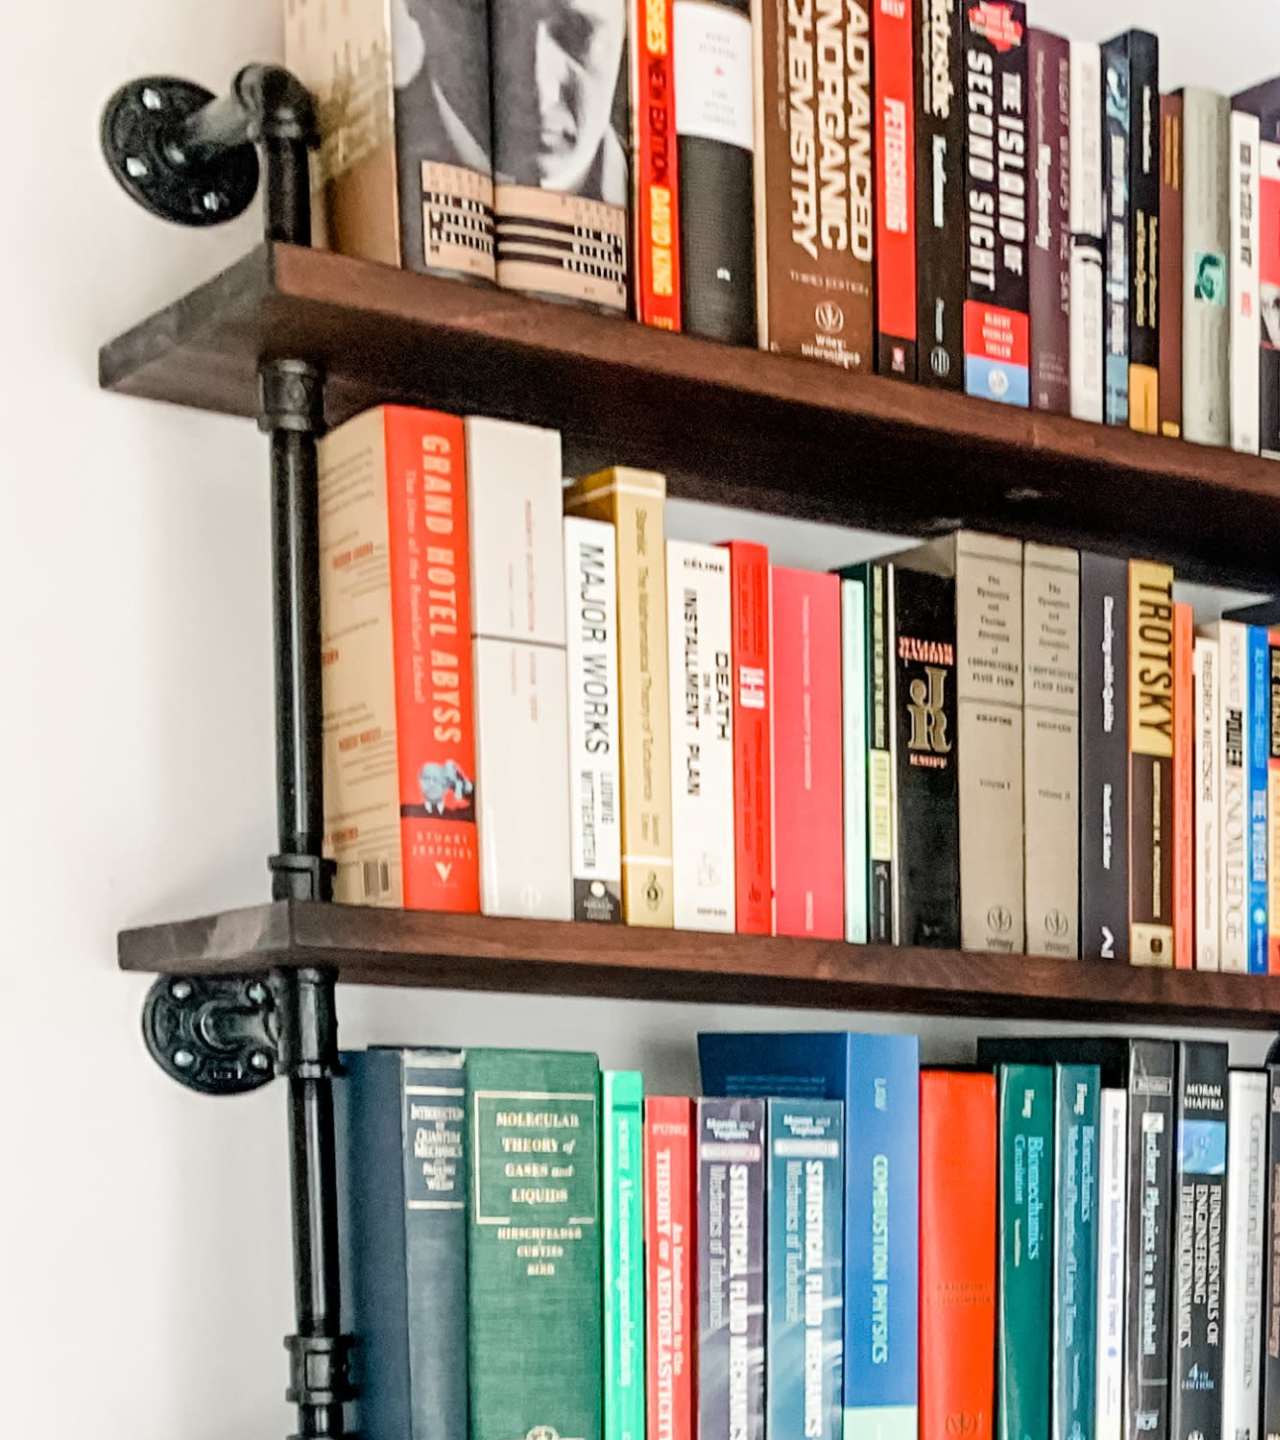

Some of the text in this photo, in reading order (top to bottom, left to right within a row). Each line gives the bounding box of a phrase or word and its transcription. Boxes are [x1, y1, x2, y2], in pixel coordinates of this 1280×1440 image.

[846, 2, 873, 262] ADVANCED
[967, 50, 996, 292] SECOND SIGHT
[421, 434, 463, 745] GRAND HOTEL ABYSS
[578, 542, 610, 756] MAJOR WORKS
[683, 588, 700, 796] INSTALLMENT PLAN
[714, 651, 731, 742] DEATH
[1136, 580, 1174, 742] TROTSKY
[496, 1110, 581, 1129] MOLECULAR
[501, 1137, 577, 1155] THEORY of
[1183, 1095, 1225, 1111] SHAPIRO
[1185, 1084, 1222, 1099] MORAN
[504, 1161, 575, 1178] GASES and
[510, 1187, 569, 1204] LIQUIDS
[728, 1164, 748, 1276] STATISTICAL
[1027, 1135, 1044, 1261] Biomechanics
[1081, 1125, 1095, 1222] Biomechanics
[496, 1224, 583, 1242] HIRSCHFELDER
[515, 1243, 565, 1259] CURTISS
[871, 1153, 888, 1364] COMBUSTION PHYSICS
[1178, 1183, 1194, 1348] THERMODYNAMICS
[1194, 1183, 1208, 1304] ENGINEERING
[1209, 1184, 1223, 1347] FUNDAMENTALS OF
[728, 1279, 748, 1334] FLUID
[804, 1160, 824, 1438] STATISTICAL FLUID MECHANICS
